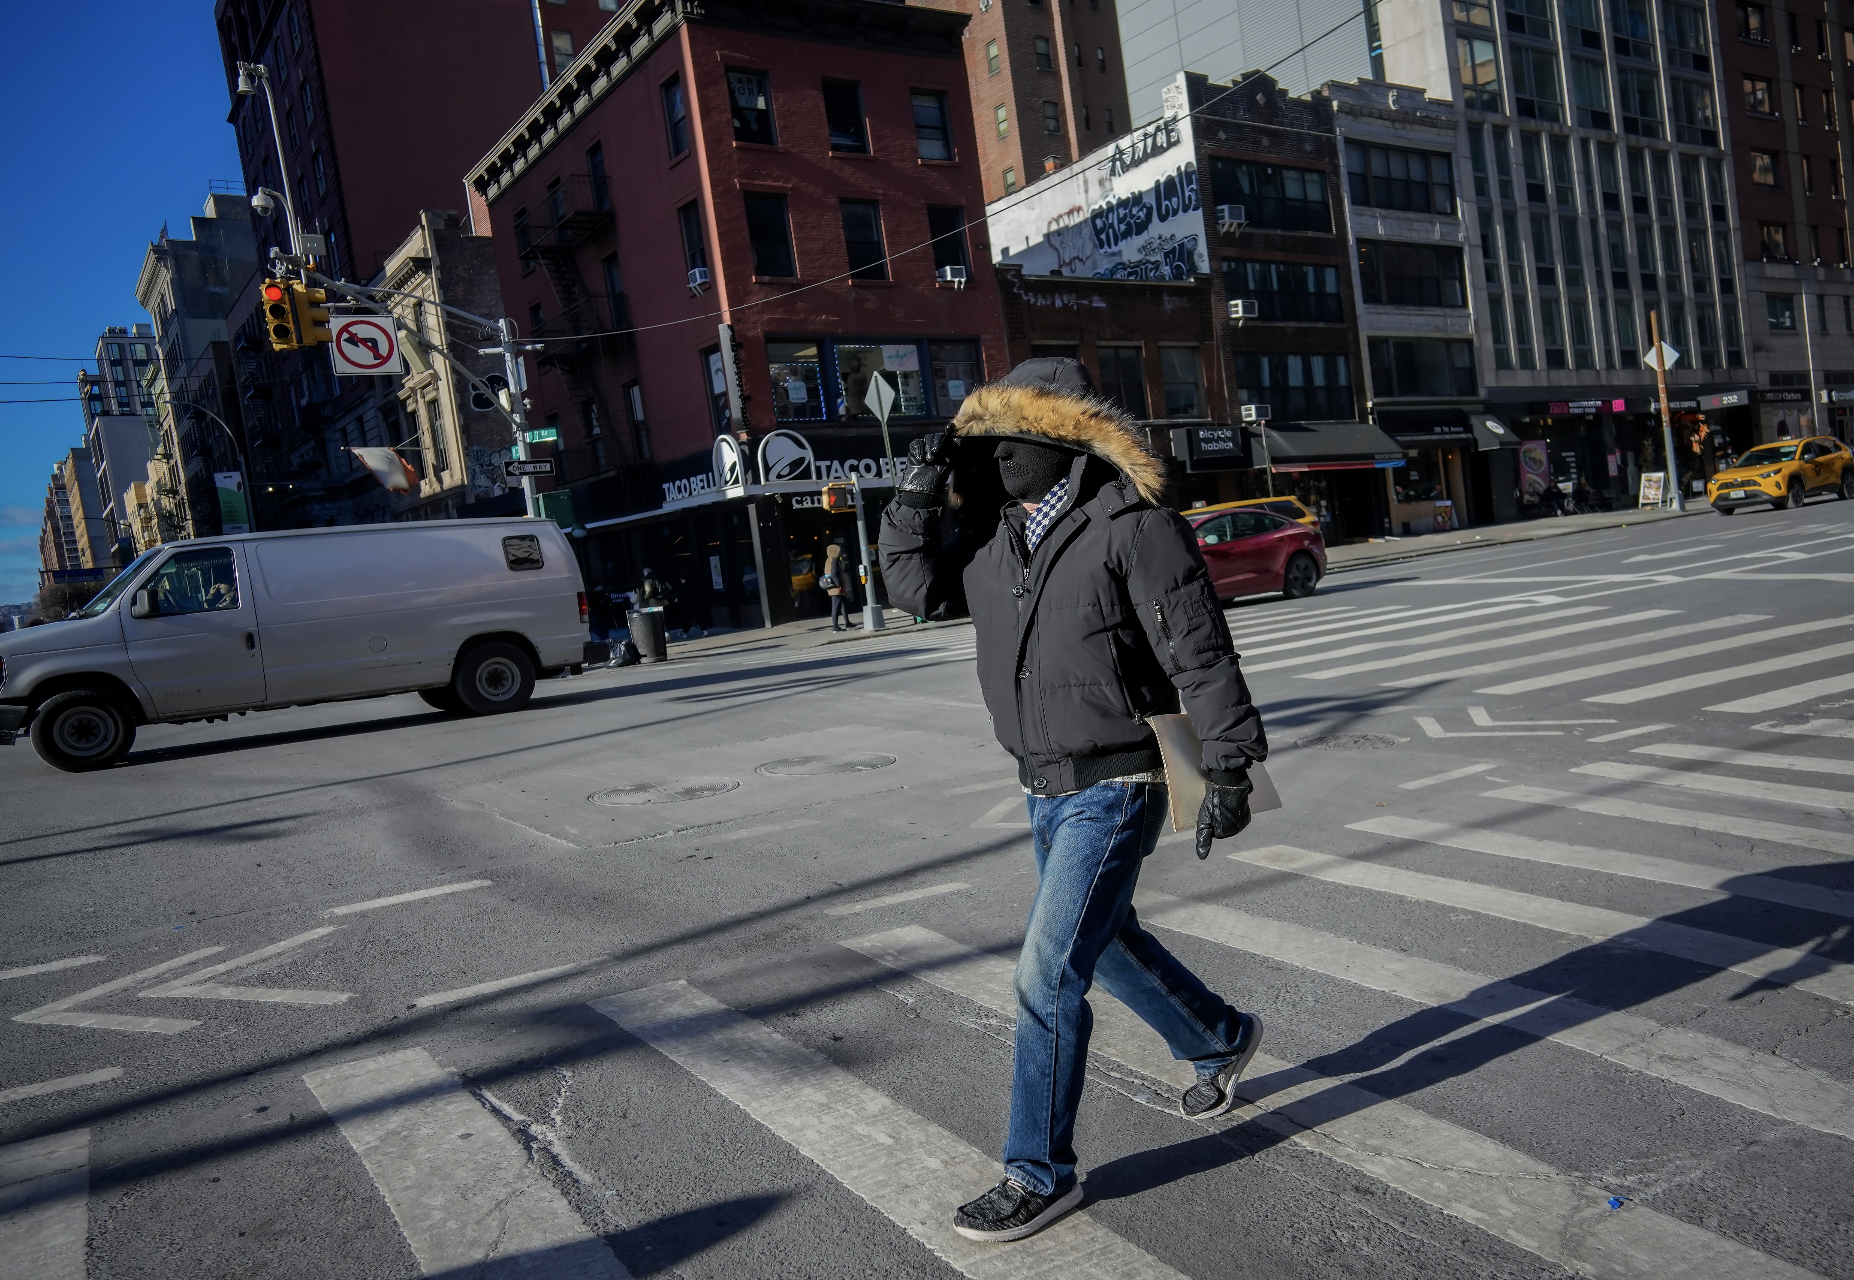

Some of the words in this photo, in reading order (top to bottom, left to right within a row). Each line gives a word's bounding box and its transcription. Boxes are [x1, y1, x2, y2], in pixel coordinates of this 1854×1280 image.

[1722, 394, 1738, 404] 232
[1199, 428, 1232, 440] bicycle
[1201, 440, 1232, 450] habitat
[816, 458, 877, 481] TACO
[880, 457, 908, 479] BE
[662, 477, 692, 502] TACO
[690, 472, 717, 496] BELL
